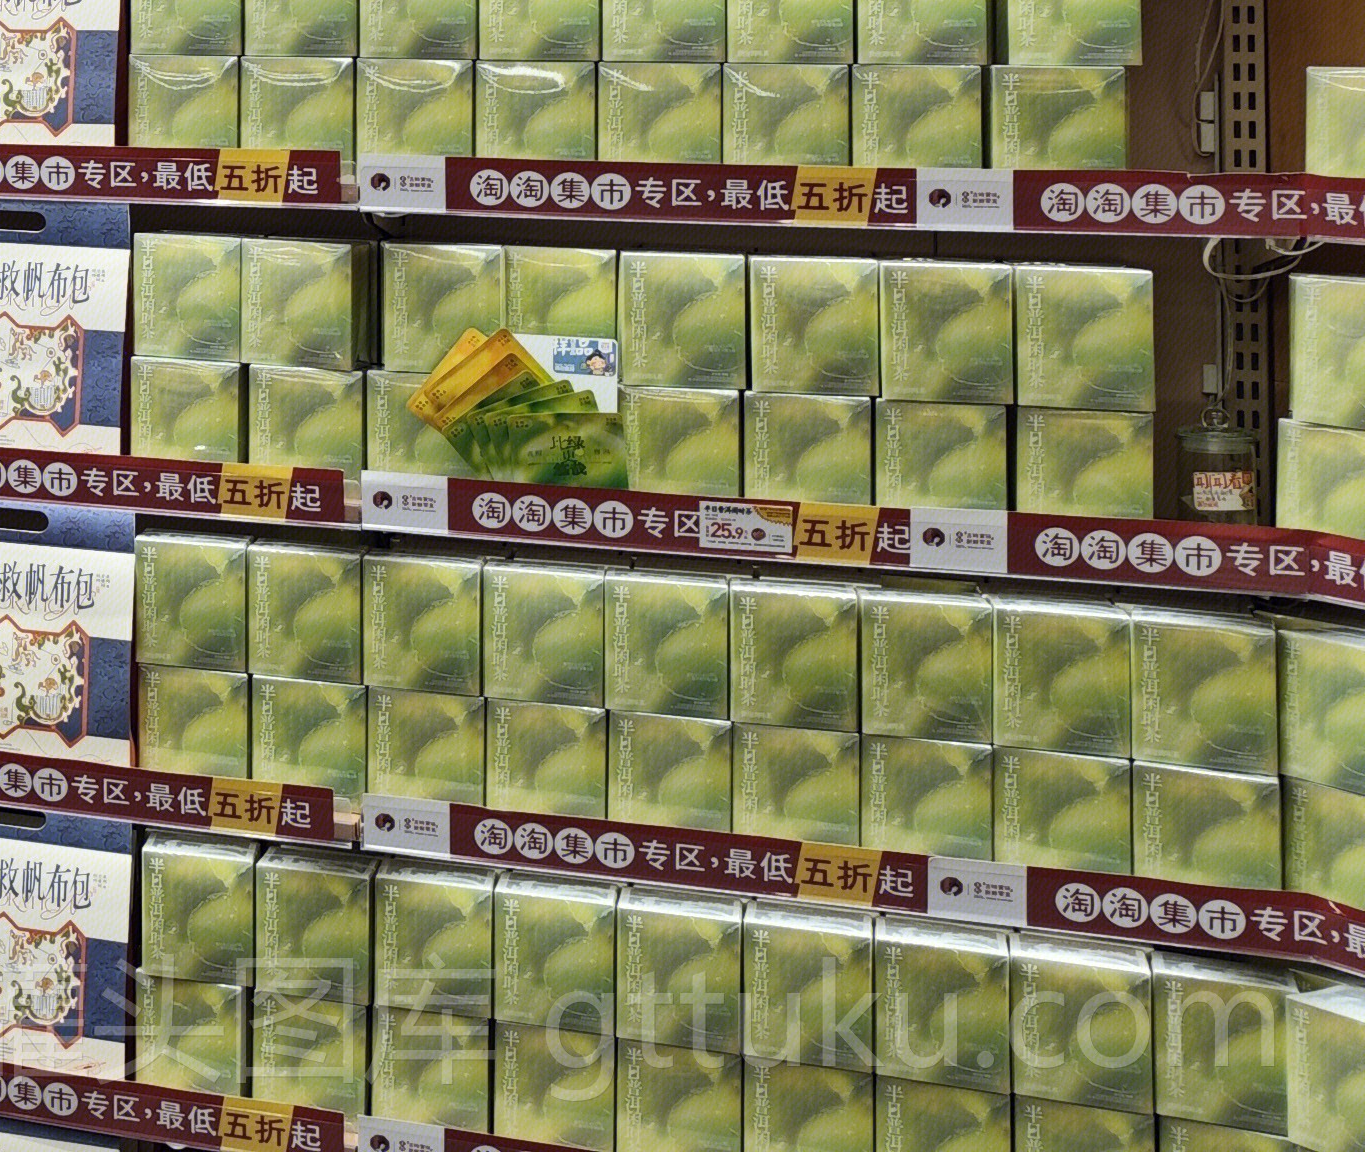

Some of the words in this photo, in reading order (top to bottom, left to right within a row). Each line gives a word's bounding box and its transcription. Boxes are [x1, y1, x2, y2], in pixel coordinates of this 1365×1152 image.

[710, 522, 744, 539] 25.9
[799, 518, 910, 553] 五折起
